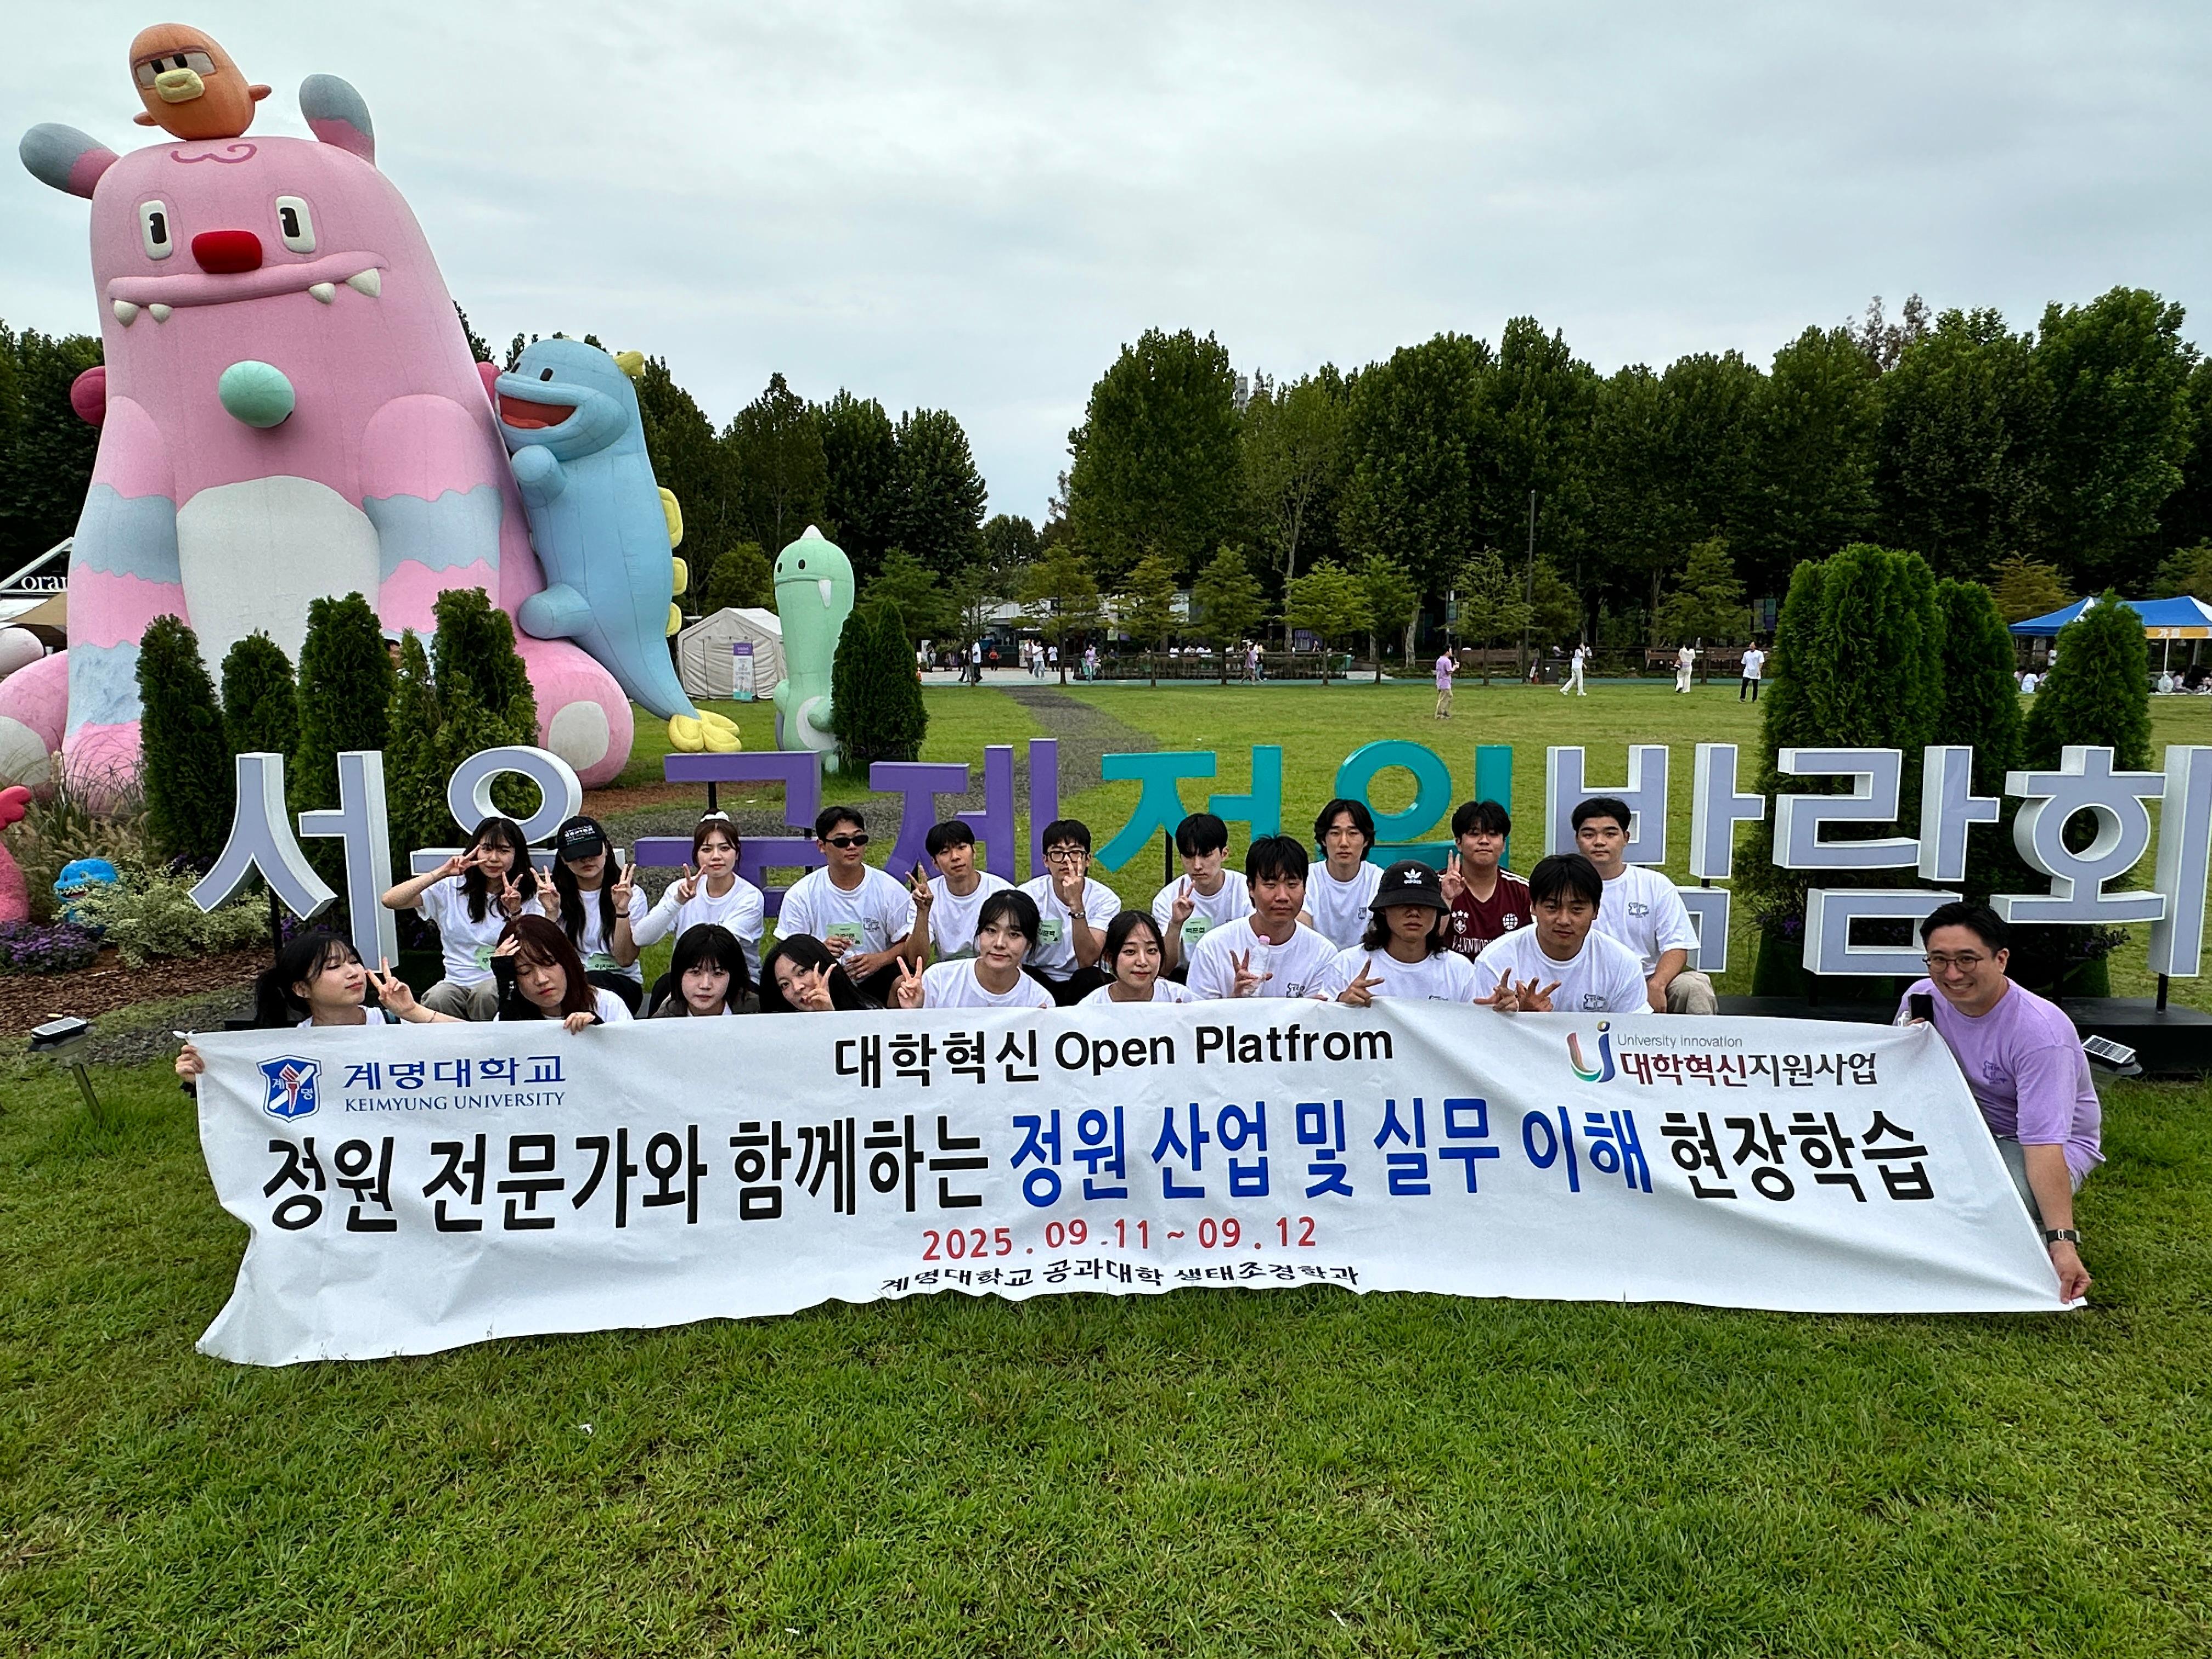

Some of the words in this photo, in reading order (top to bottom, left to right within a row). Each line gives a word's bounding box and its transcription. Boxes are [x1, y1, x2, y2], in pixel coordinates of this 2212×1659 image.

[836, 1030, 1039, 1088] 대학혁신
[1055, 1032, 1175, 1076] Open
[1196, 1024, 1392, 1064] Platfrom
[1617, 1034, 1677, 1048] University
[343, 1056, 566, 1090] 계명대학교
[1620, 1053, 1877, 1087] 대학혁신지원사업
[346, 1097, 447, 1111] KEIMYUNG
[455, 1092, 565, 1109] UNIVERSITY
[263, 1137, 397, 1232] 정원
[422, 1125, 707, 1232] 전문가와
[730, 1115, 988, 1221] 함께하는
[1010, 1106, 1127, 1207] 정원
[1152, 1101, 1269, 1199] 산업
[1296, 1100, 1353, 1198] 및
[1374, 1098, 1500, 1195] 실무
[1522, 1106, 1653, 1193] 이해
[1660, 1111, 1934, 1202] 현장학습
[881, 1268, 1034, 1291] 계명대학교
[1043, 1258, 1164, 1286] 공과대학
[1174, 1262, 1358, 1285] 생태조경학과
